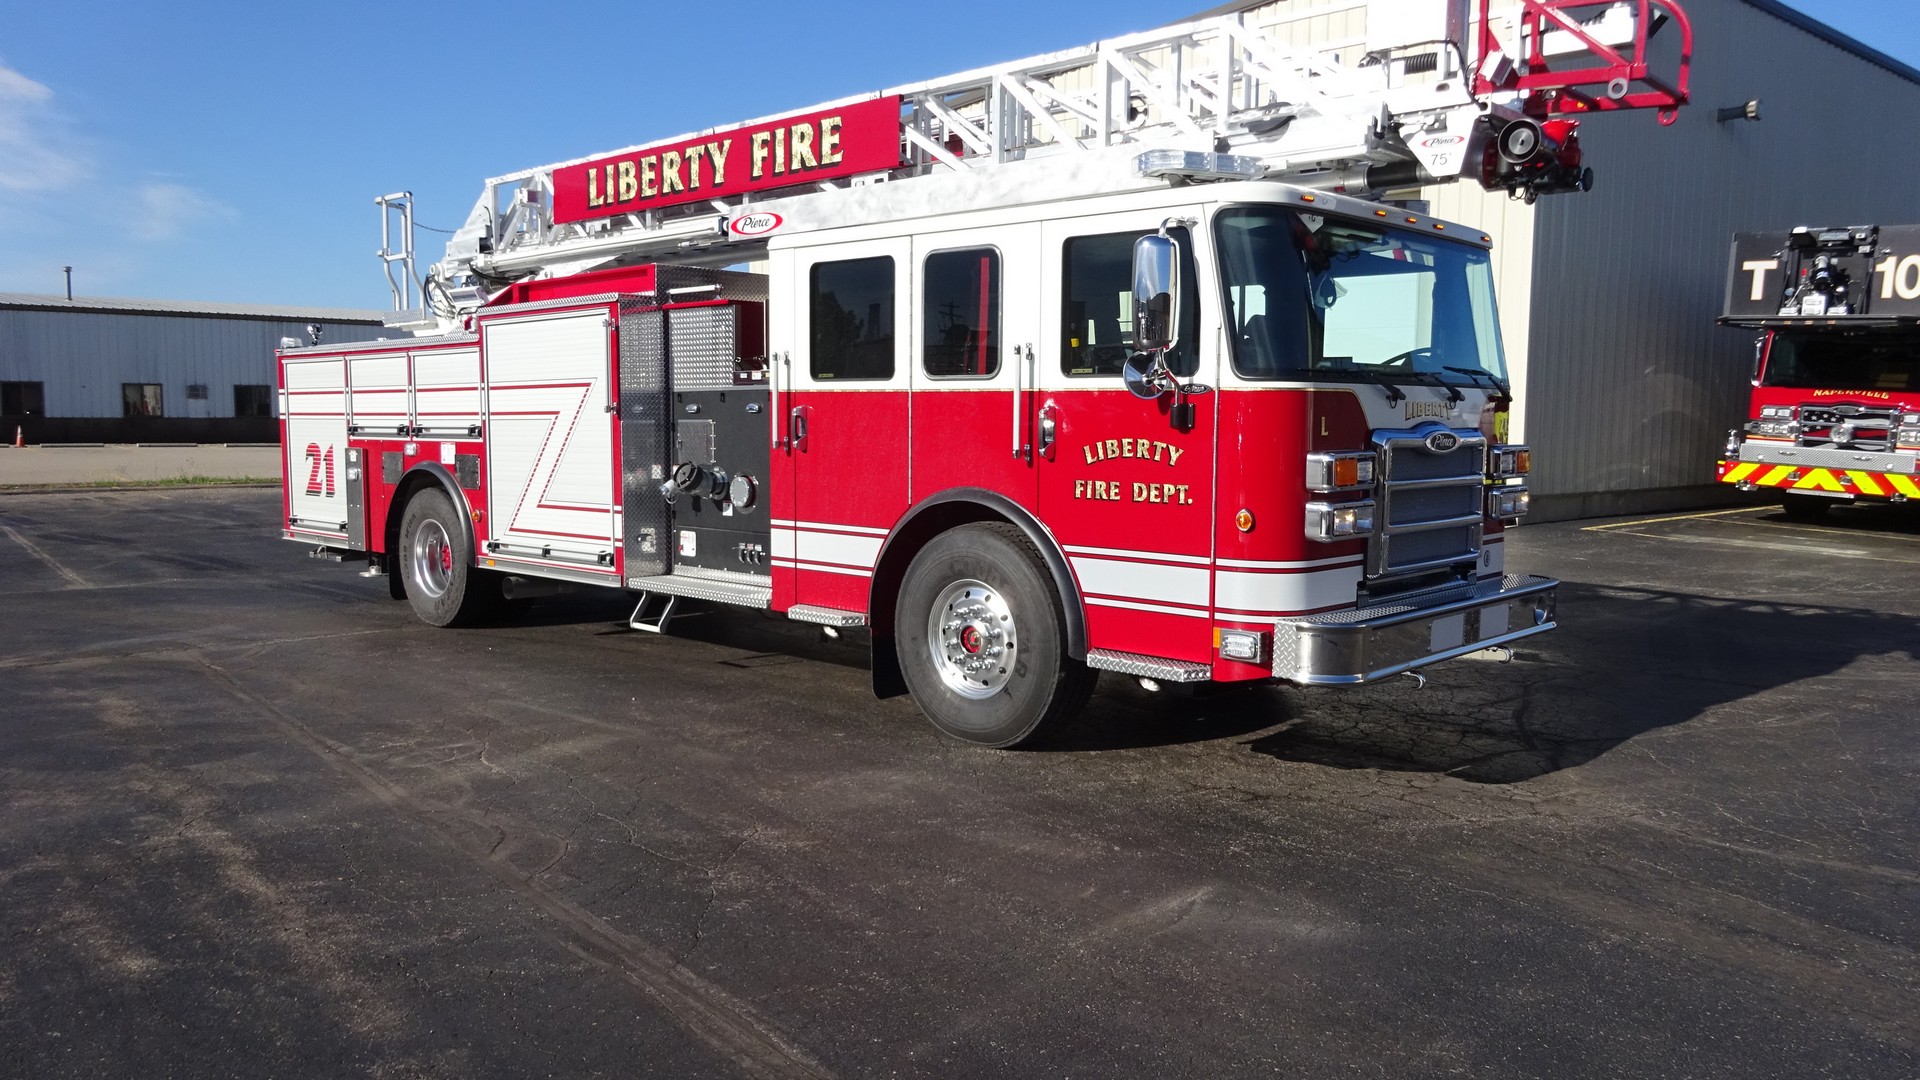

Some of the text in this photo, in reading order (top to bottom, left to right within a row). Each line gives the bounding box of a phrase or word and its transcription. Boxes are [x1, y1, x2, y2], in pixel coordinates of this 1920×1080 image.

[588, 116, 844, 210] LIBERTY FIRE
[741, 216, 770, 231] Pierce
[1742, 260, 1779, 301] T
[1813, 389, 1889, 400] NAPERVILLE
[1405, 400, 1451, 421] LIBERTY
[1320, 416, 1329, 437] L
[1083, 438, 1184, 467] LIBERTY
[305, 442, 336, 498] 21
[1074, 479, 1193, 505] FIRE DEPT.
